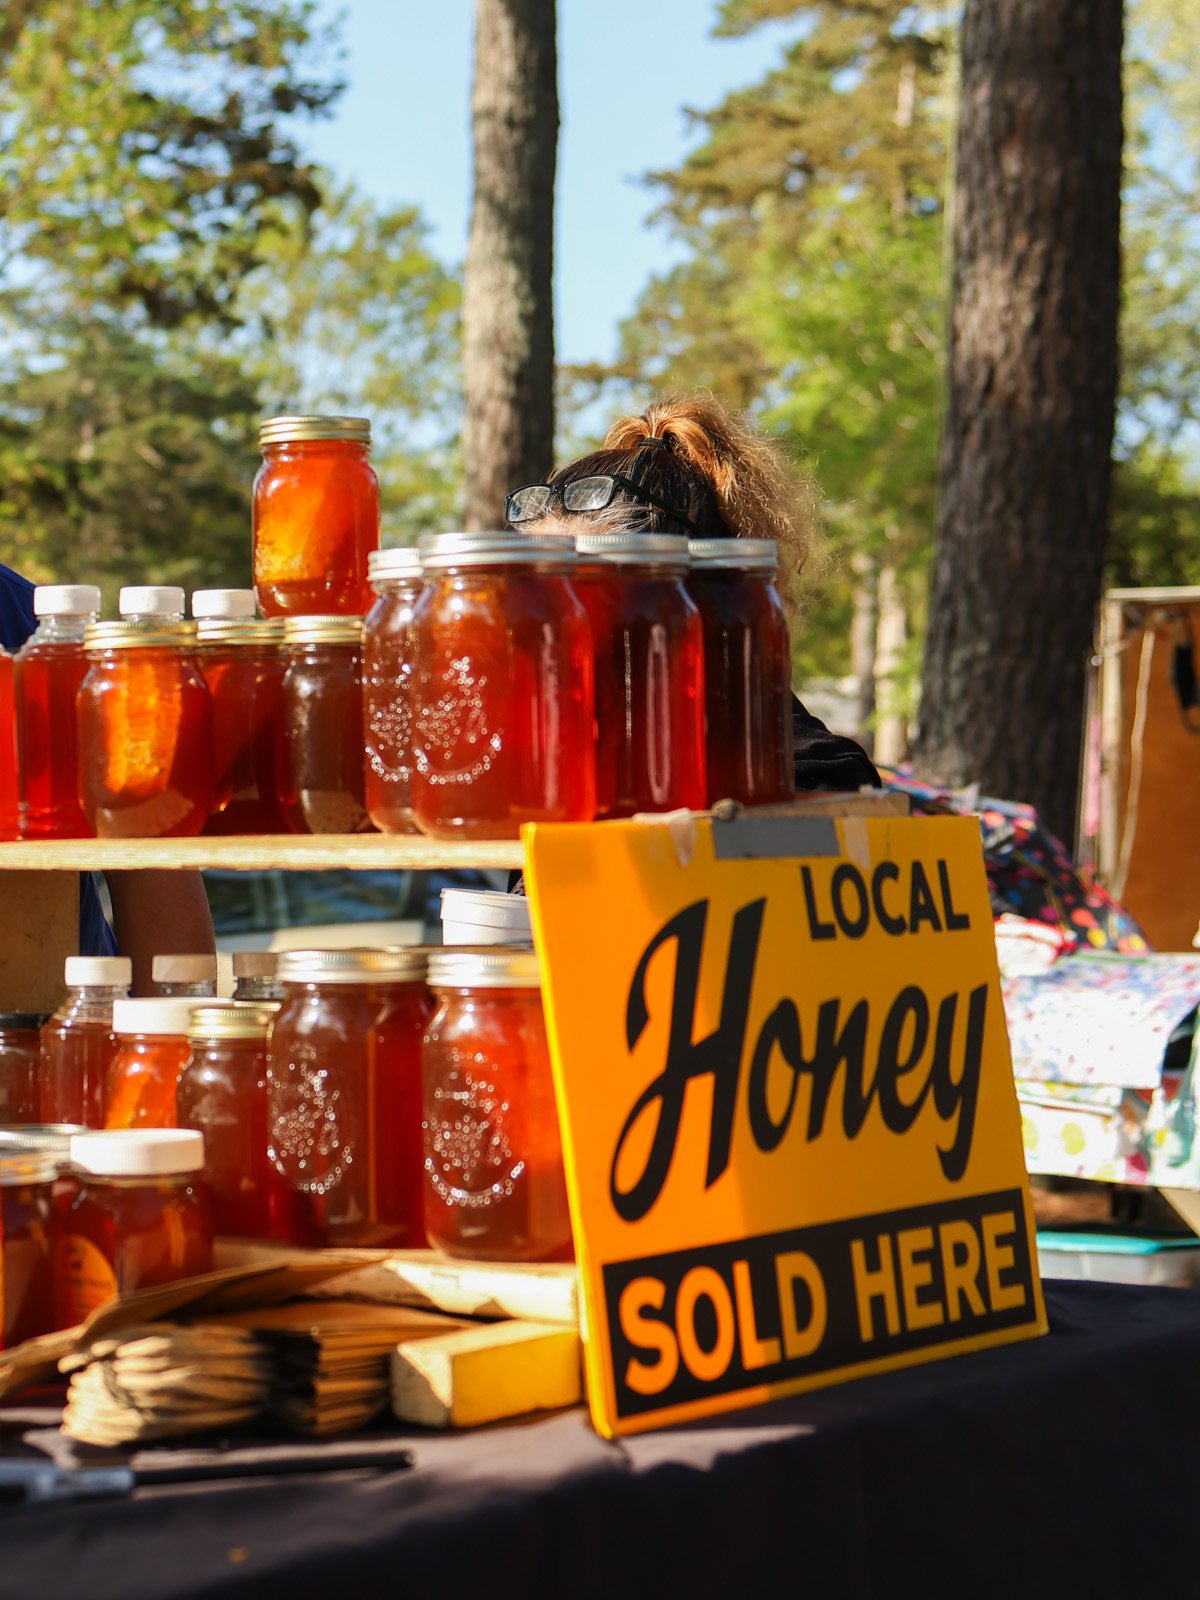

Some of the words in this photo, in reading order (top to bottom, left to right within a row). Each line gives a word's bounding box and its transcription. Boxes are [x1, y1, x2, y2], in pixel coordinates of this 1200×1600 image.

[801, 859, 970, 941] LOCAL
[610, 896, 988, 1222] Honey
[619, 1251, 827, 1395] SOLD
[850, 1211, 1026, 1343] HERE
